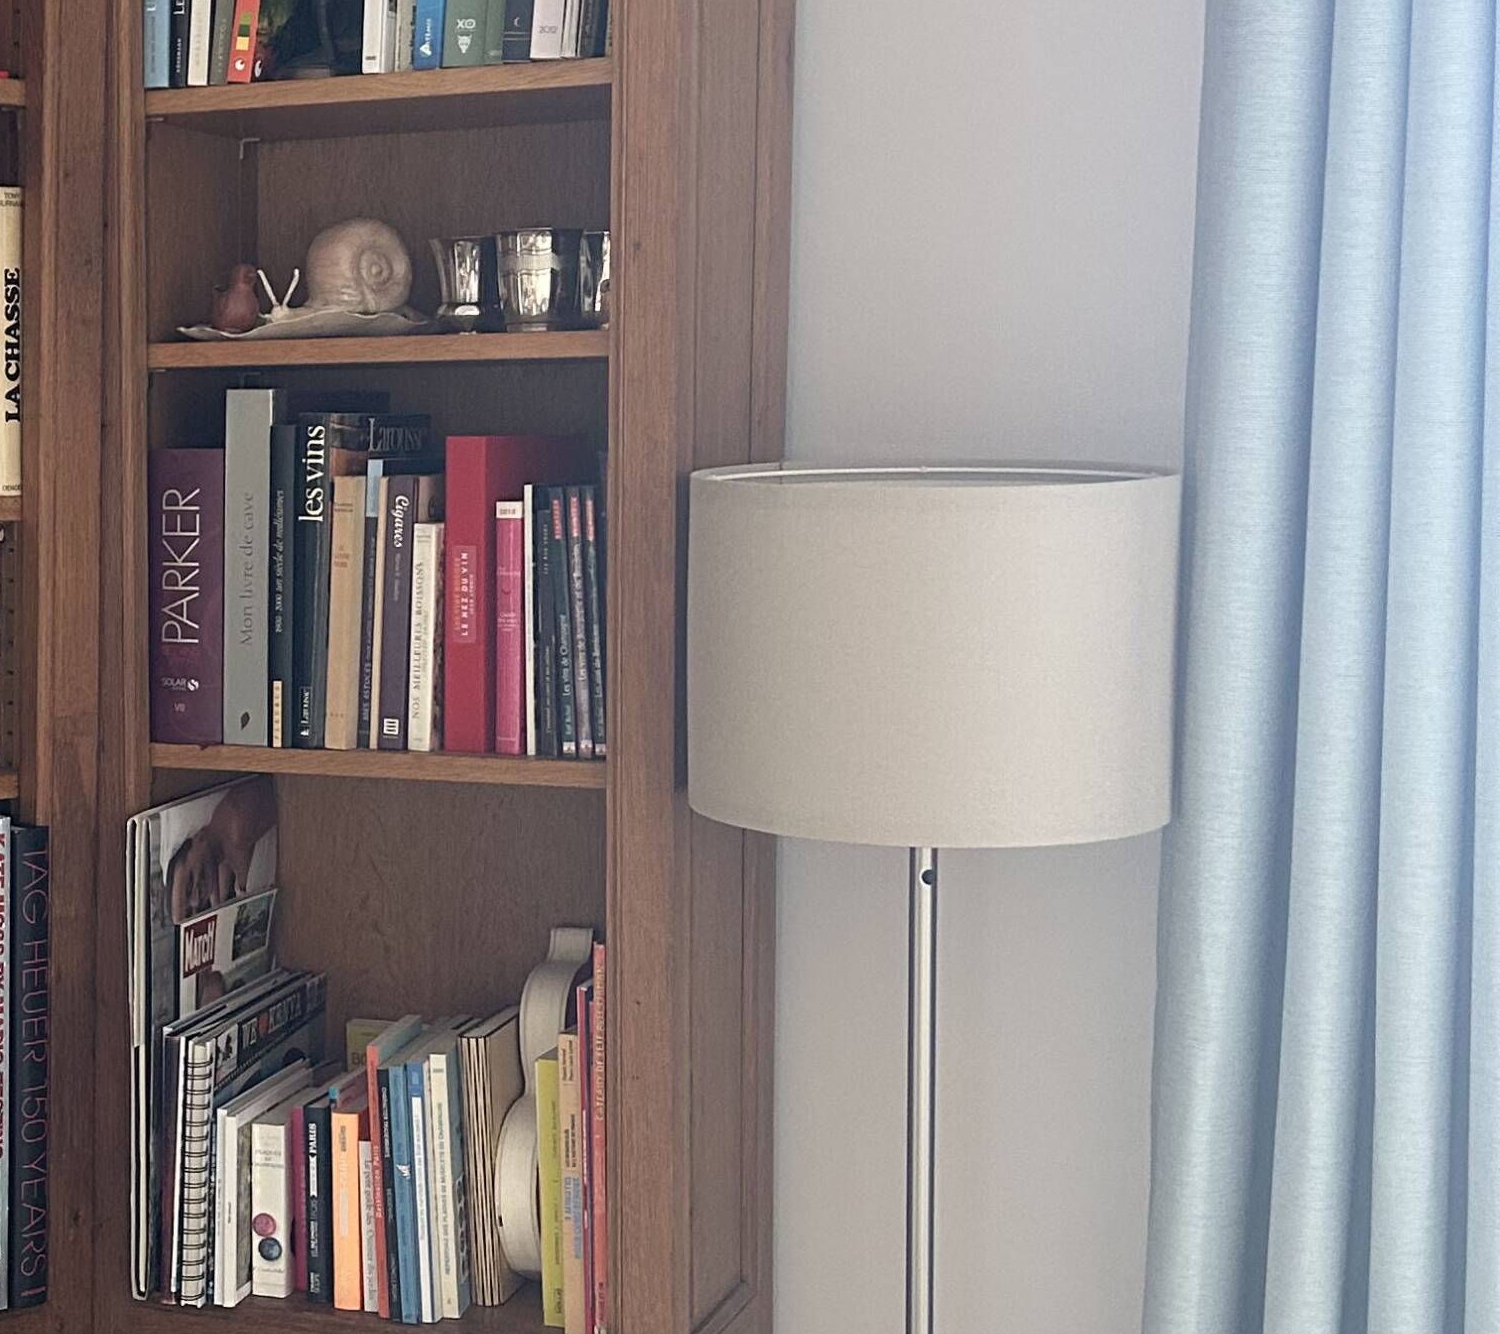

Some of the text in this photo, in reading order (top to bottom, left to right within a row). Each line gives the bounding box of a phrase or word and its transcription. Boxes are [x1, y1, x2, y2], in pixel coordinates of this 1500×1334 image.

[4, 267, 21, 423] LA CHASSE
[298, 424, 326, 523] les vins
[392, 495, 409, 549] Cigares
[160, 486, 201, 644] PARKER
[238, 492, 255, 646] Mon livre de cave
[461, 551, 469, 636] LE NEZ DU VIN
[161, 677, 188, 687] SOLAR
[20, 850, 49, 1277] TAG HEUER 150 YEARS
[308, 1123, 318, 1155] PARIS
